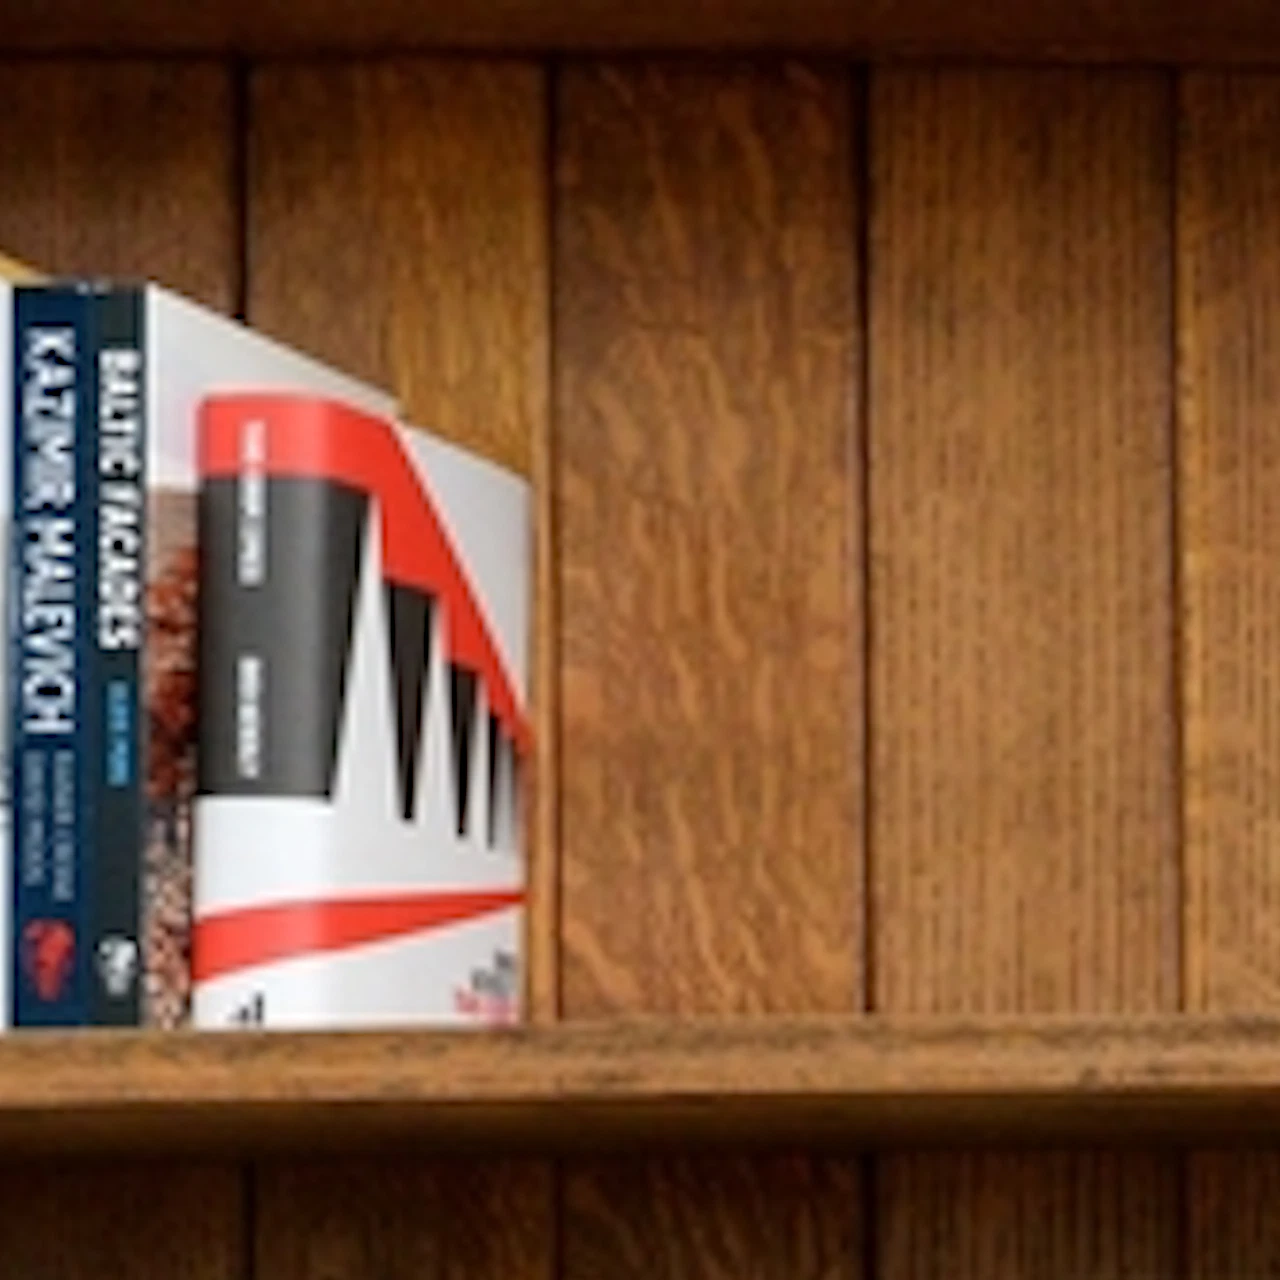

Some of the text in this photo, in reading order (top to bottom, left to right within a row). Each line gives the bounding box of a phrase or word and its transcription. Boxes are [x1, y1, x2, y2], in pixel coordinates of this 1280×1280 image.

[21, 327, 77, 735] KAZIMIR MALEVICH
[98, 350, 139, 477] BALTIC
